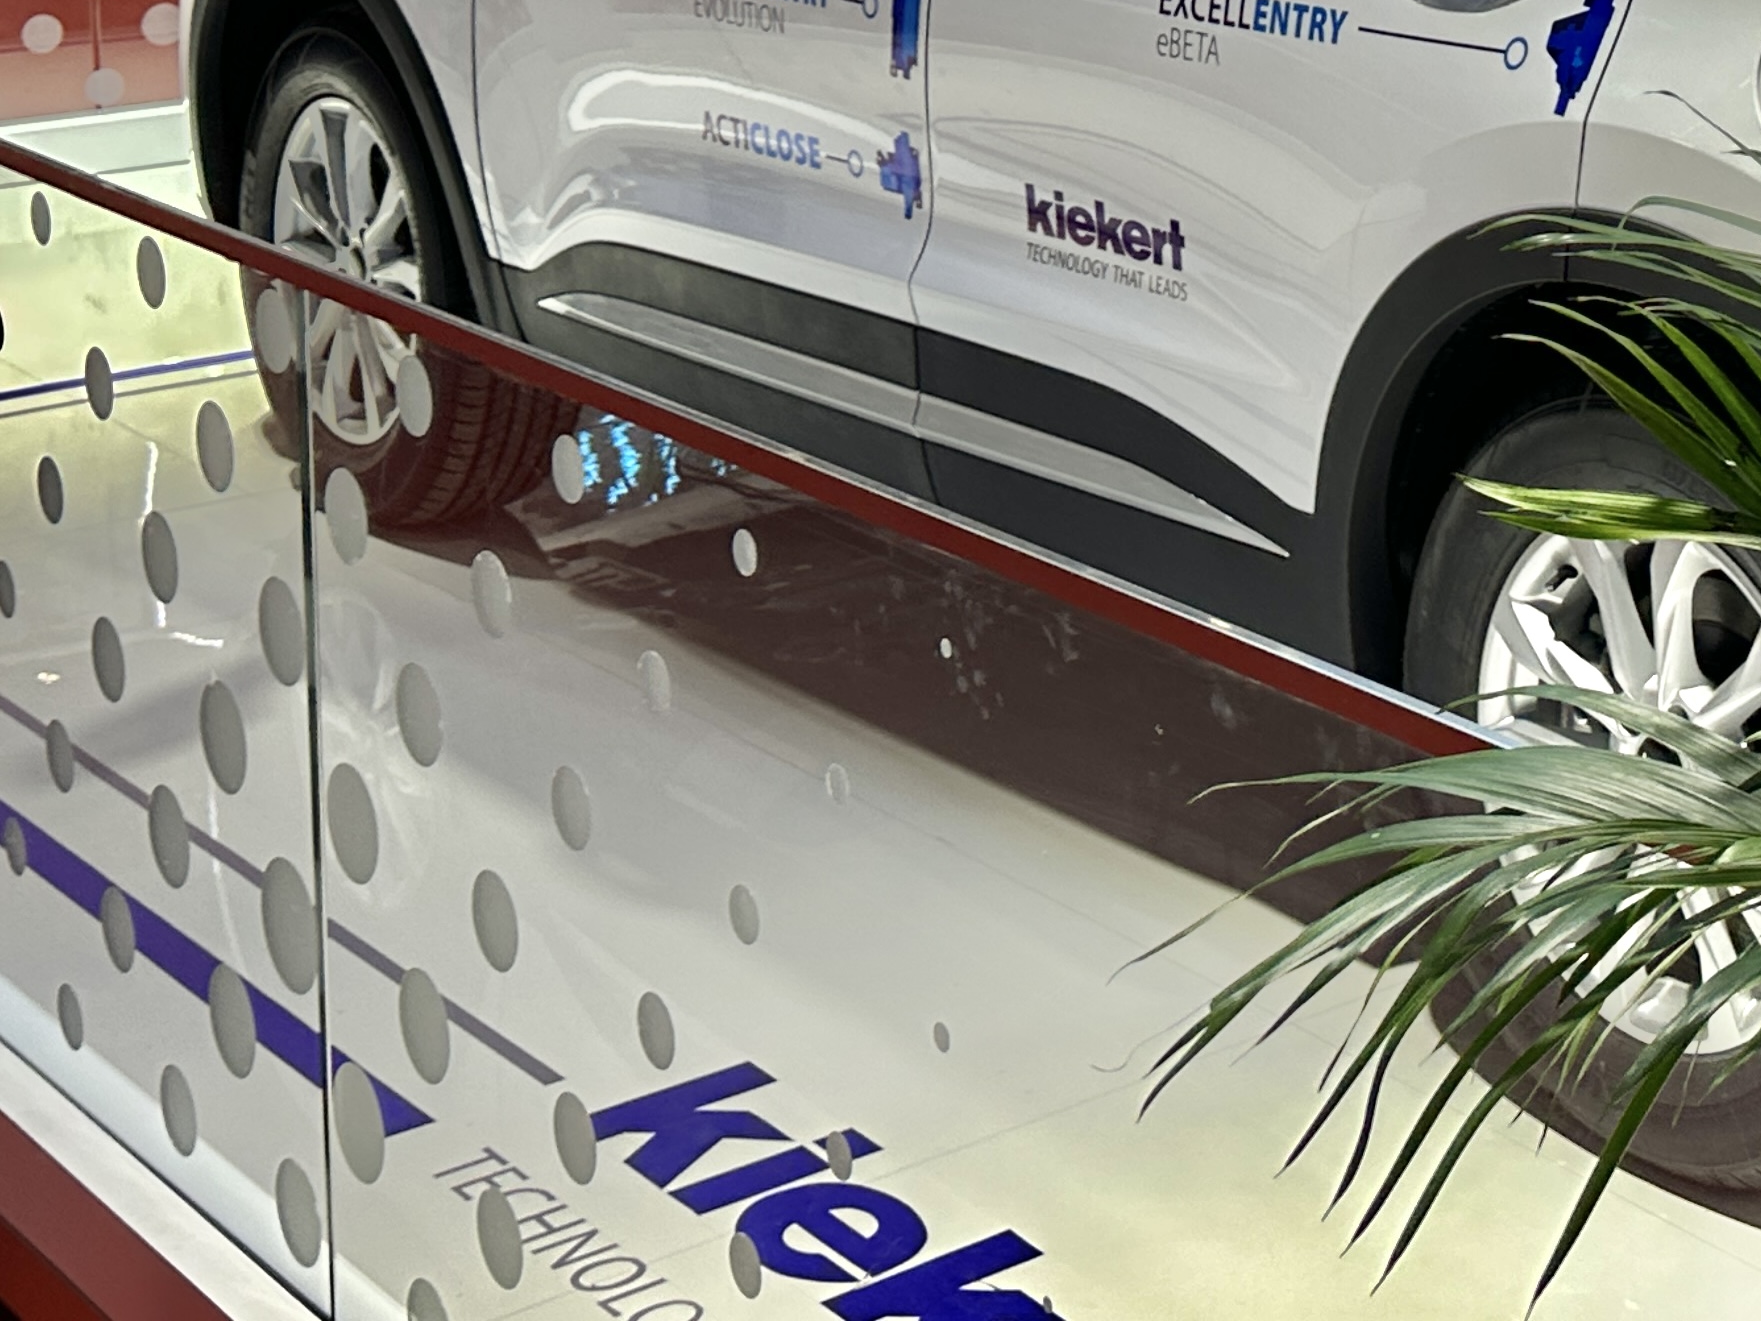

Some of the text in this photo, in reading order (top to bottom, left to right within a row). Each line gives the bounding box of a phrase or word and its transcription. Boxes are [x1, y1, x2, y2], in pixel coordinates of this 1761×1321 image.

[1156, 27, 1221, 66] eBETA
[702, 110, 822, 169] ACTICLOSE
[1025, 182, 1186, 272] kiekert
[1027, 242, 1188, 302] TECHNOLOGY THAT LEADS
